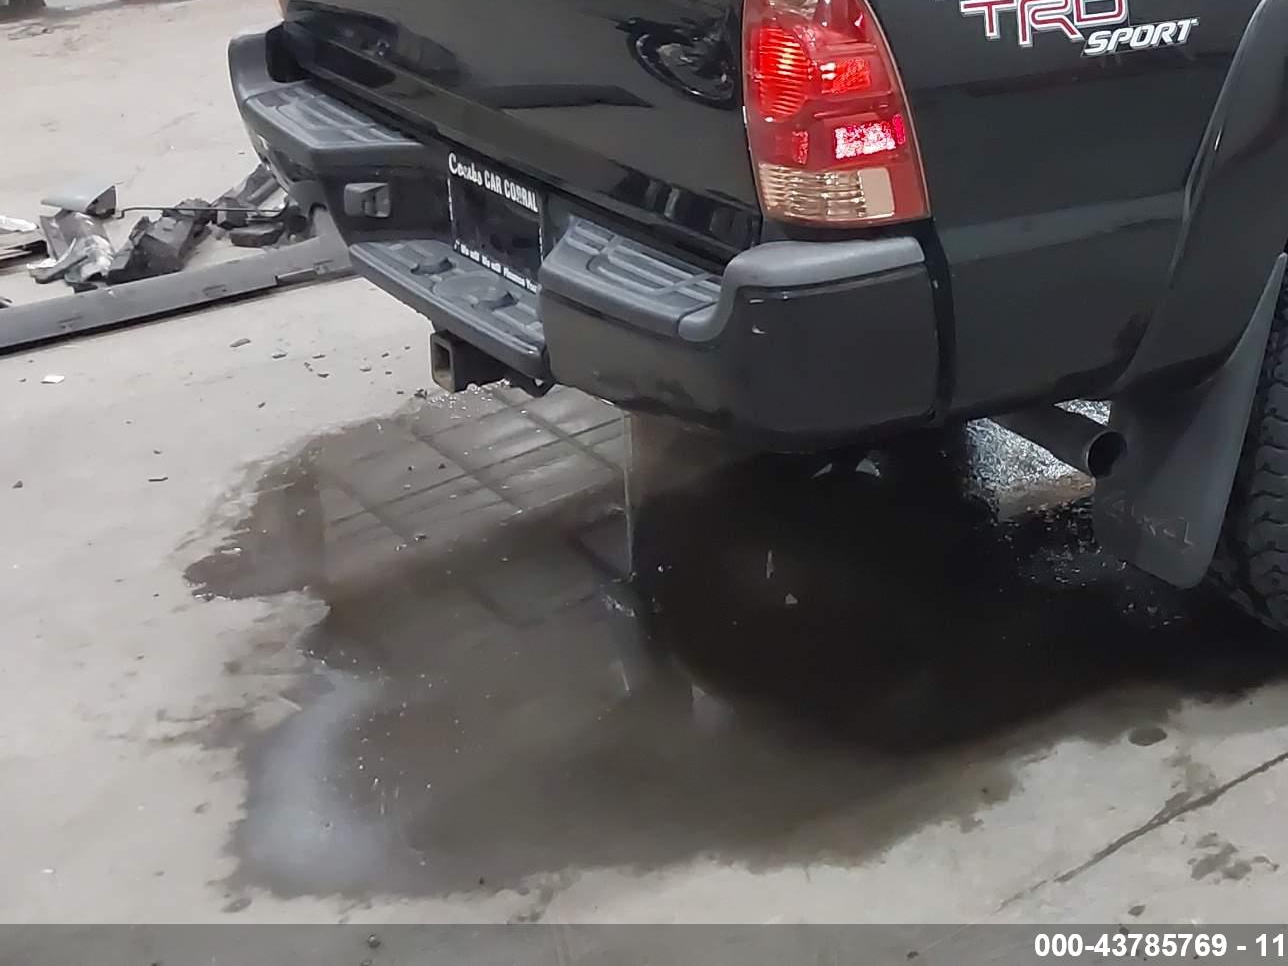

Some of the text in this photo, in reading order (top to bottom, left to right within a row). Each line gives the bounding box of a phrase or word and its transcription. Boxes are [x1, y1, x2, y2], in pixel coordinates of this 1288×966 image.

[1083, 18, 1199, 56] SPORT
[483, 170, 502, 195] CAR
[503, 179, 539, 213] CORRAL
